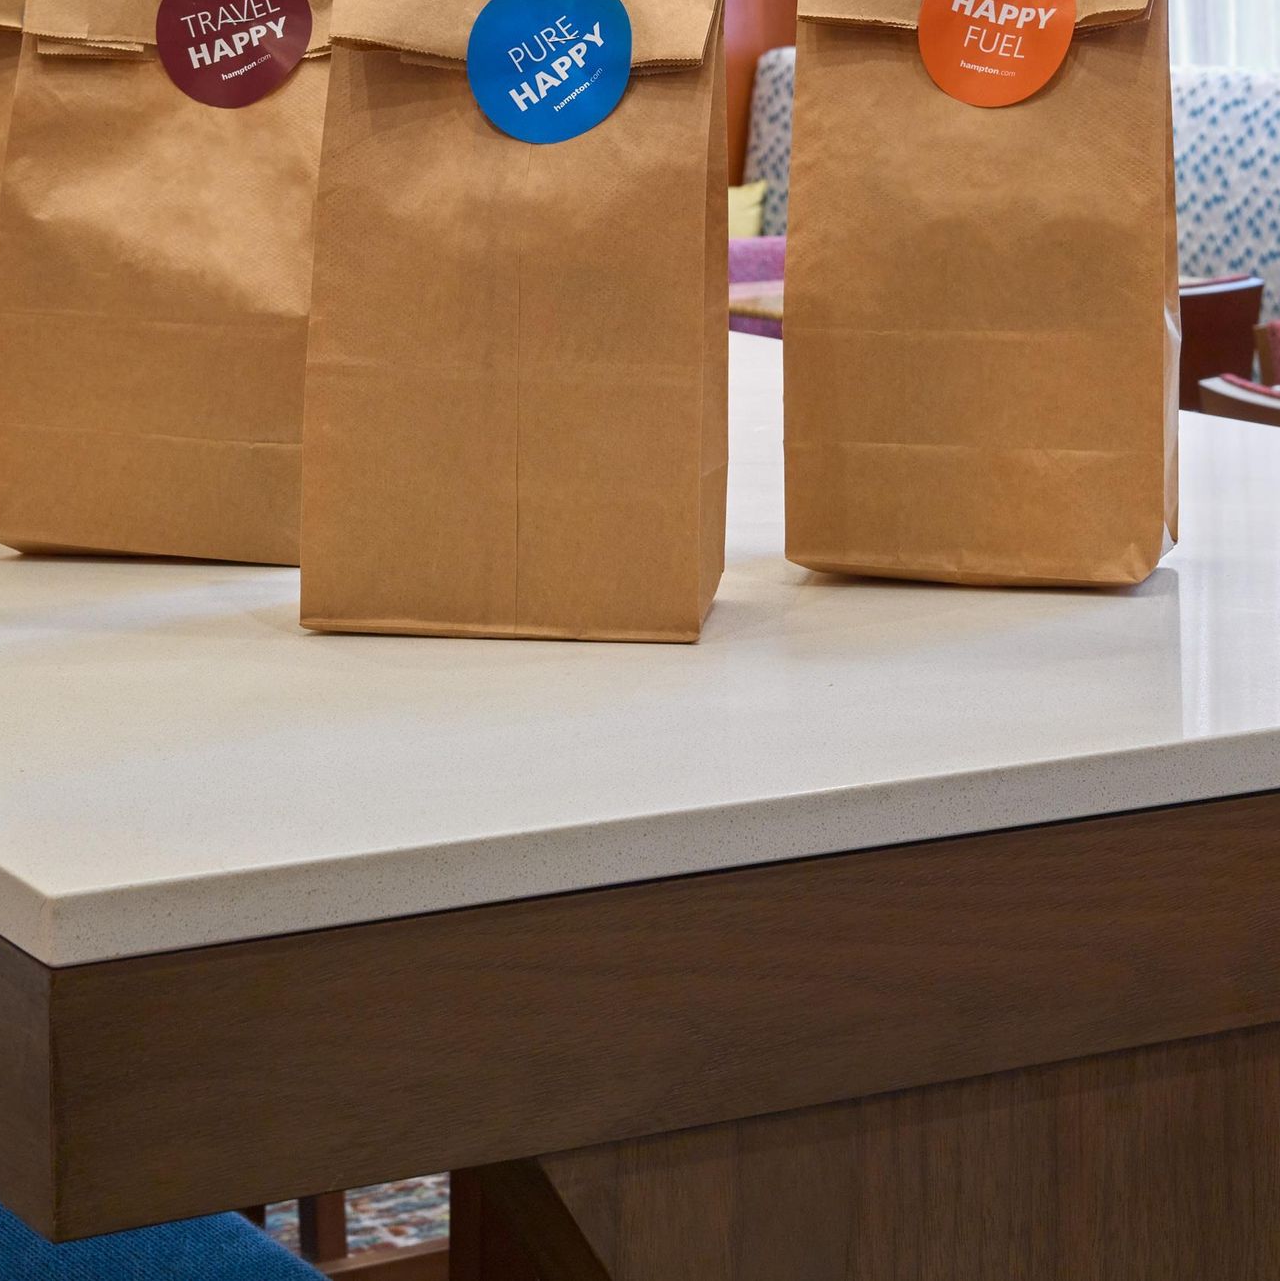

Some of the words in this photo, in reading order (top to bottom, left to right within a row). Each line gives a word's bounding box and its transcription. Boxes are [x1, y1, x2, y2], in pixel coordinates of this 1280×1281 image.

[187, 16, 286, 69] HAPPY
[507, 15, 580, 73] PURE
[963, 25, 1025, 59] FUEL
[221, 53, 272, 81] hampton.com
[508, 21, 605, 112] HAPPY
[959, 59, 1016, 78] hampton.com
[553, 67, 603, 112] hampton.com
